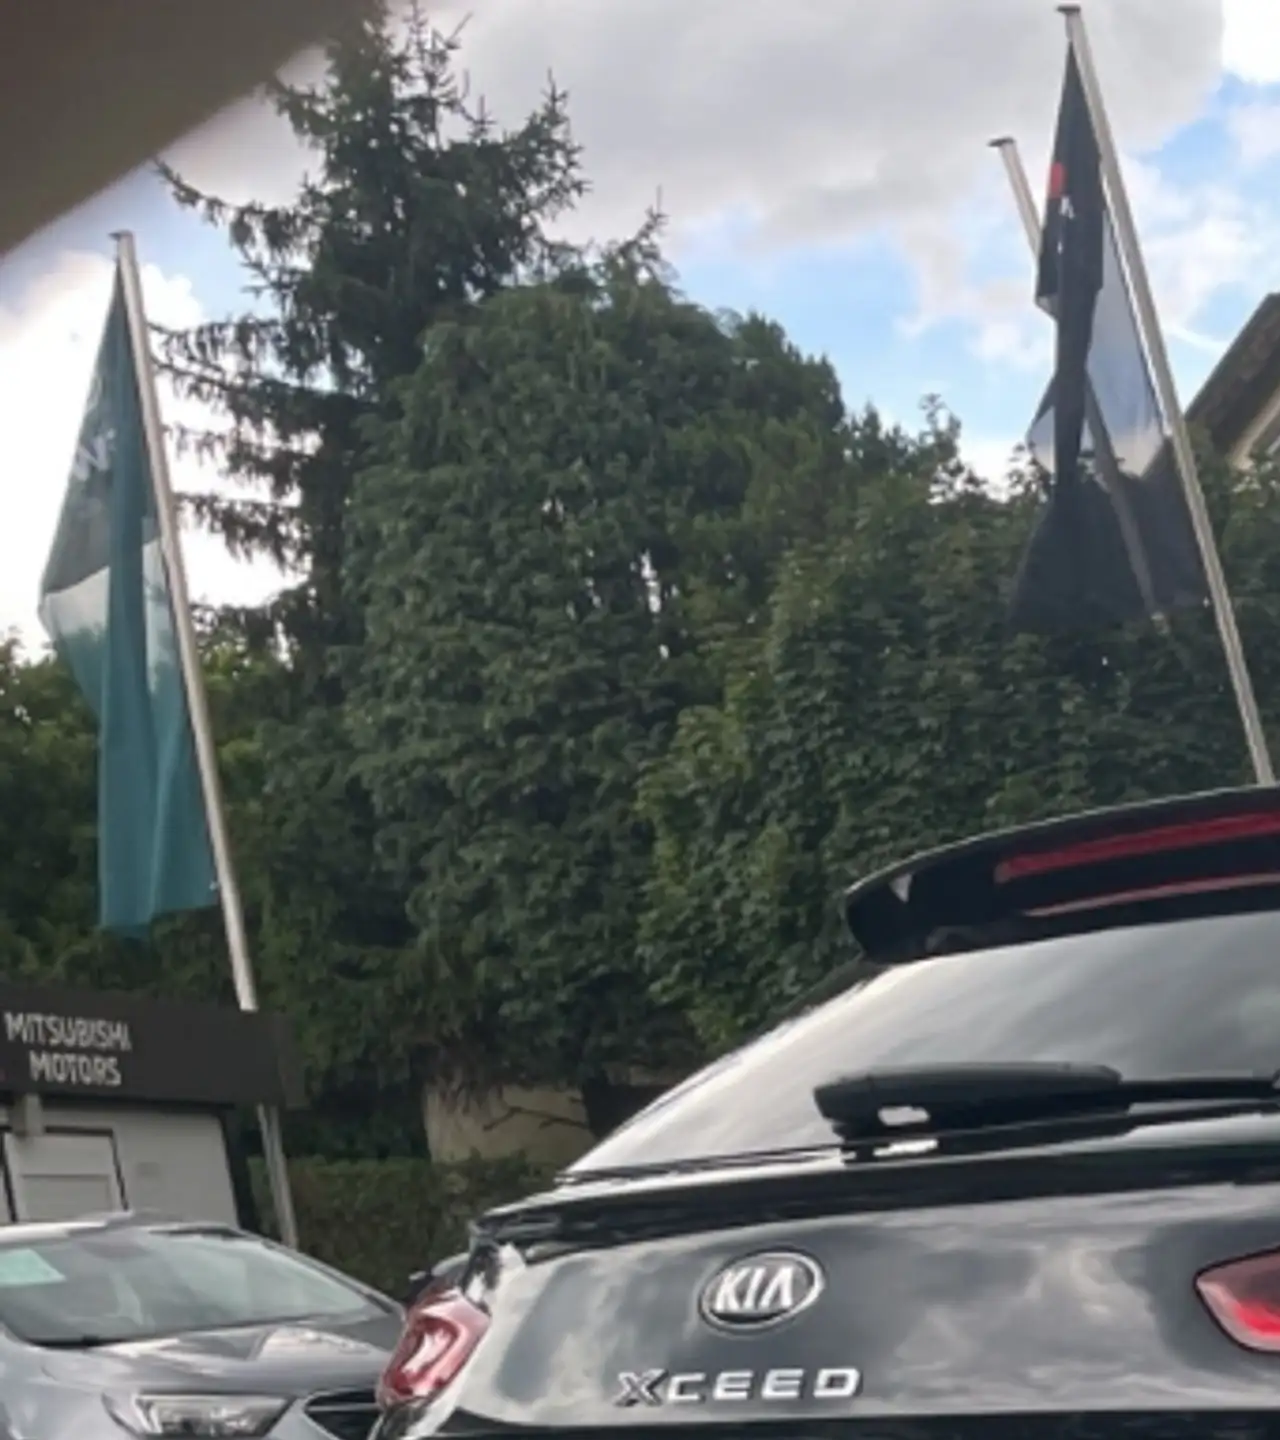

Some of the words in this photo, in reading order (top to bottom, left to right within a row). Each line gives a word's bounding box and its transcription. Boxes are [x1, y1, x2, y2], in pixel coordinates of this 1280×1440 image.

[4, 1011, 133, 1051] MITSUBISHI
[29, 1050, 122, 1087] MOTORS
[713, 1265, 797, 1313] KIA
[614, 1366, 863, 1408] XCEED
